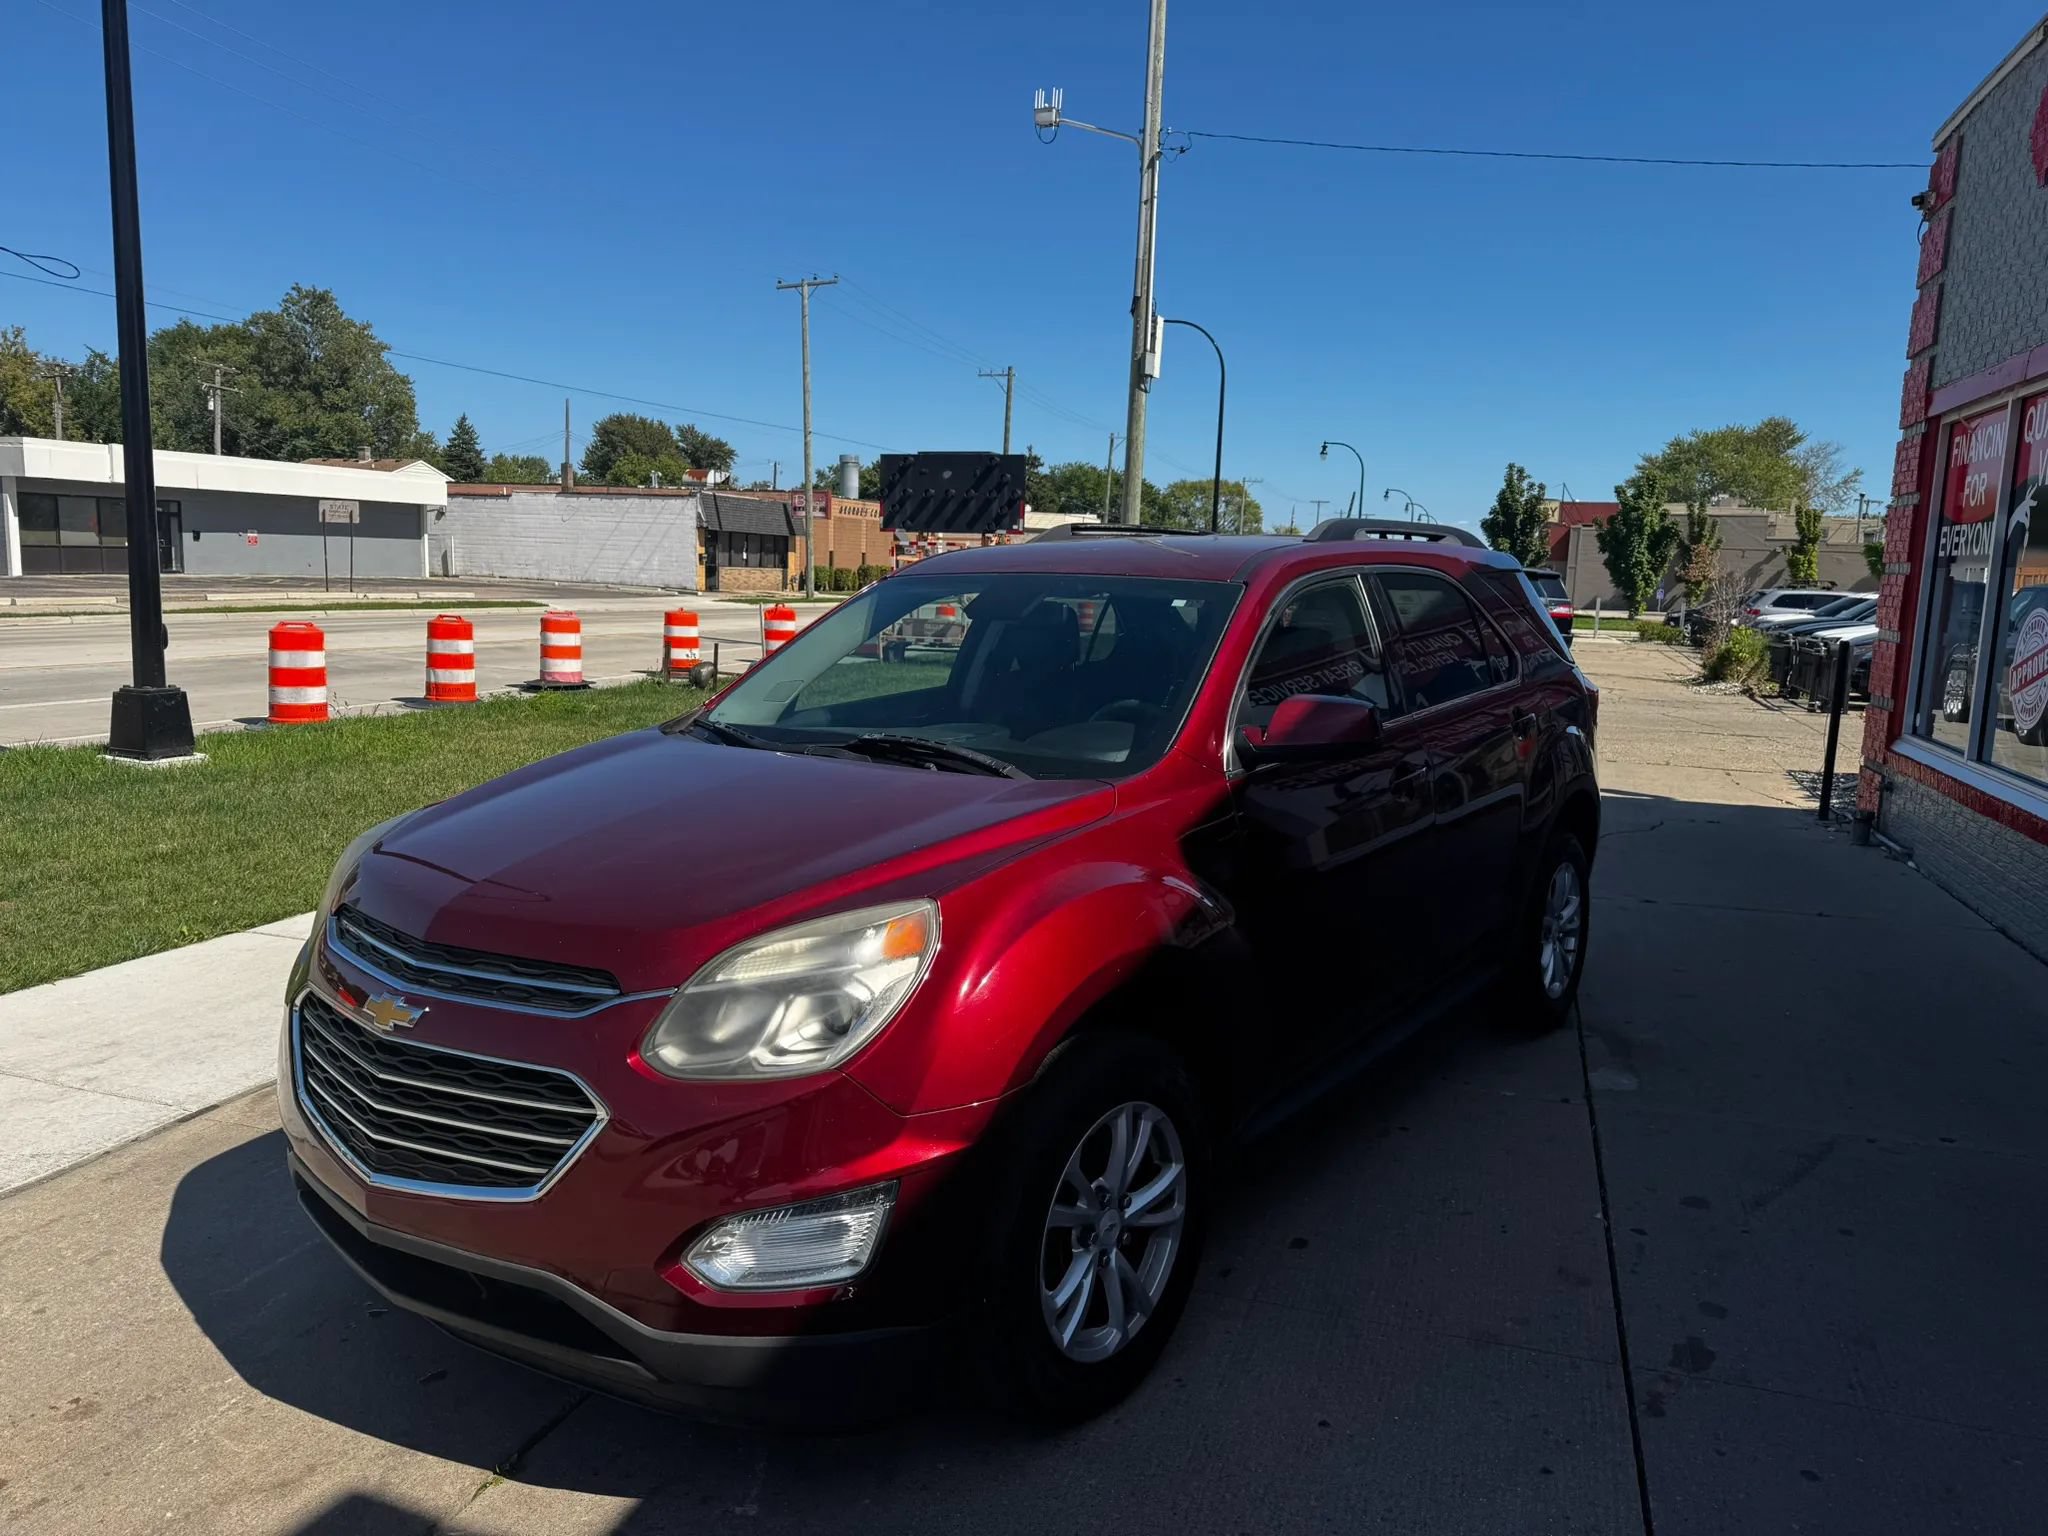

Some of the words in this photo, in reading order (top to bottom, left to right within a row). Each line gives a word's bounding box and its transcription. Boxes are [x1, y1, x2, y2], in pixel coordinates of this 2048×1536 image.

[1951, 421, 2006, 468] FINANCIN
[1963, 472, 1988, 508] FOR
[1939, 521, 1993, 557] EVERYON
[2011, 647, 2048, 691] APPROVE
